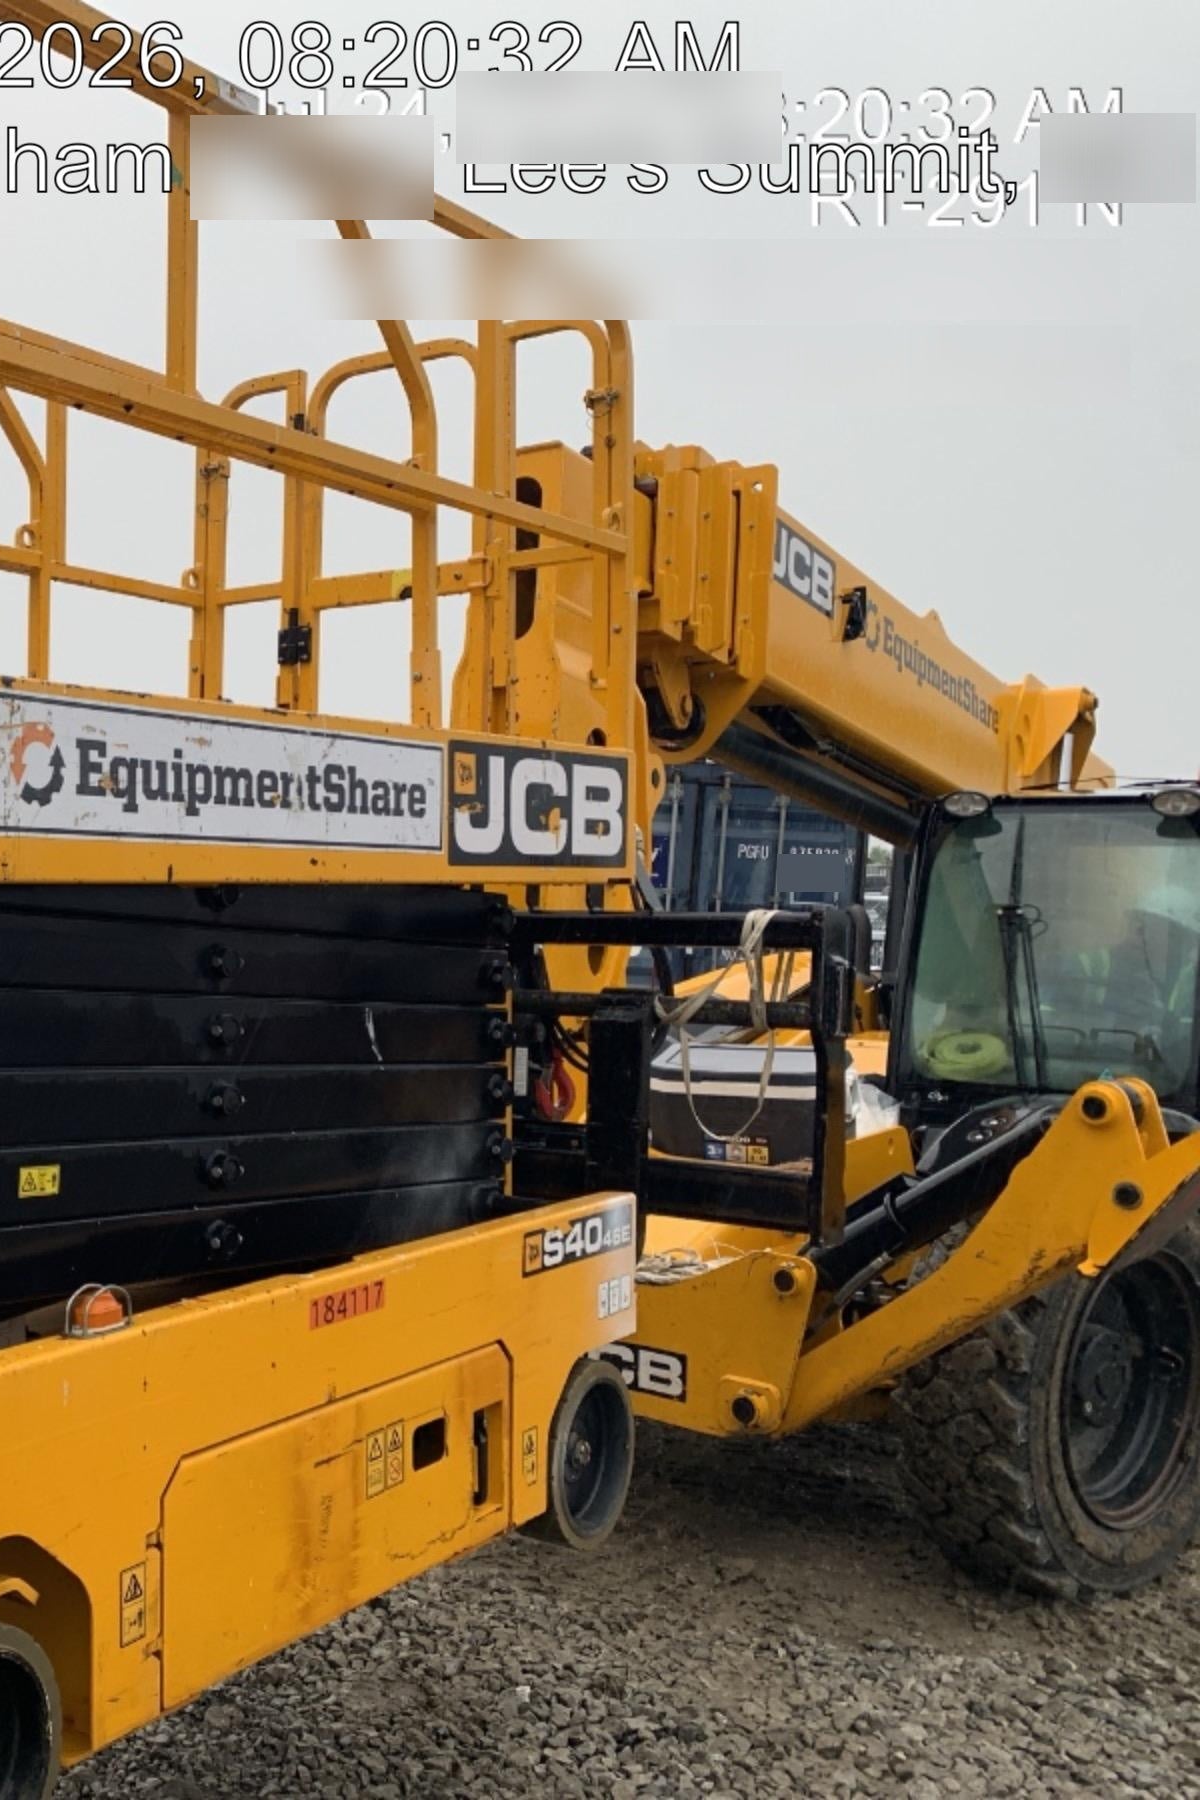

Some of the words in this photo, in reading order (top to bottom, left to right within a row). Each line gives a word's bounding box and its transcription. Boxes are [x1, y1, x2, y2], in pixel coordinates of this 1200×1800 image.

[774, 527, 834, 612] JCB
[883, 616, 999, 734] EquipmentShare
[76, 738, 427, 818] EquipmentShare
[453, 755, 624, 857] JCB
[310, 1281, 384, 1329] 184117
